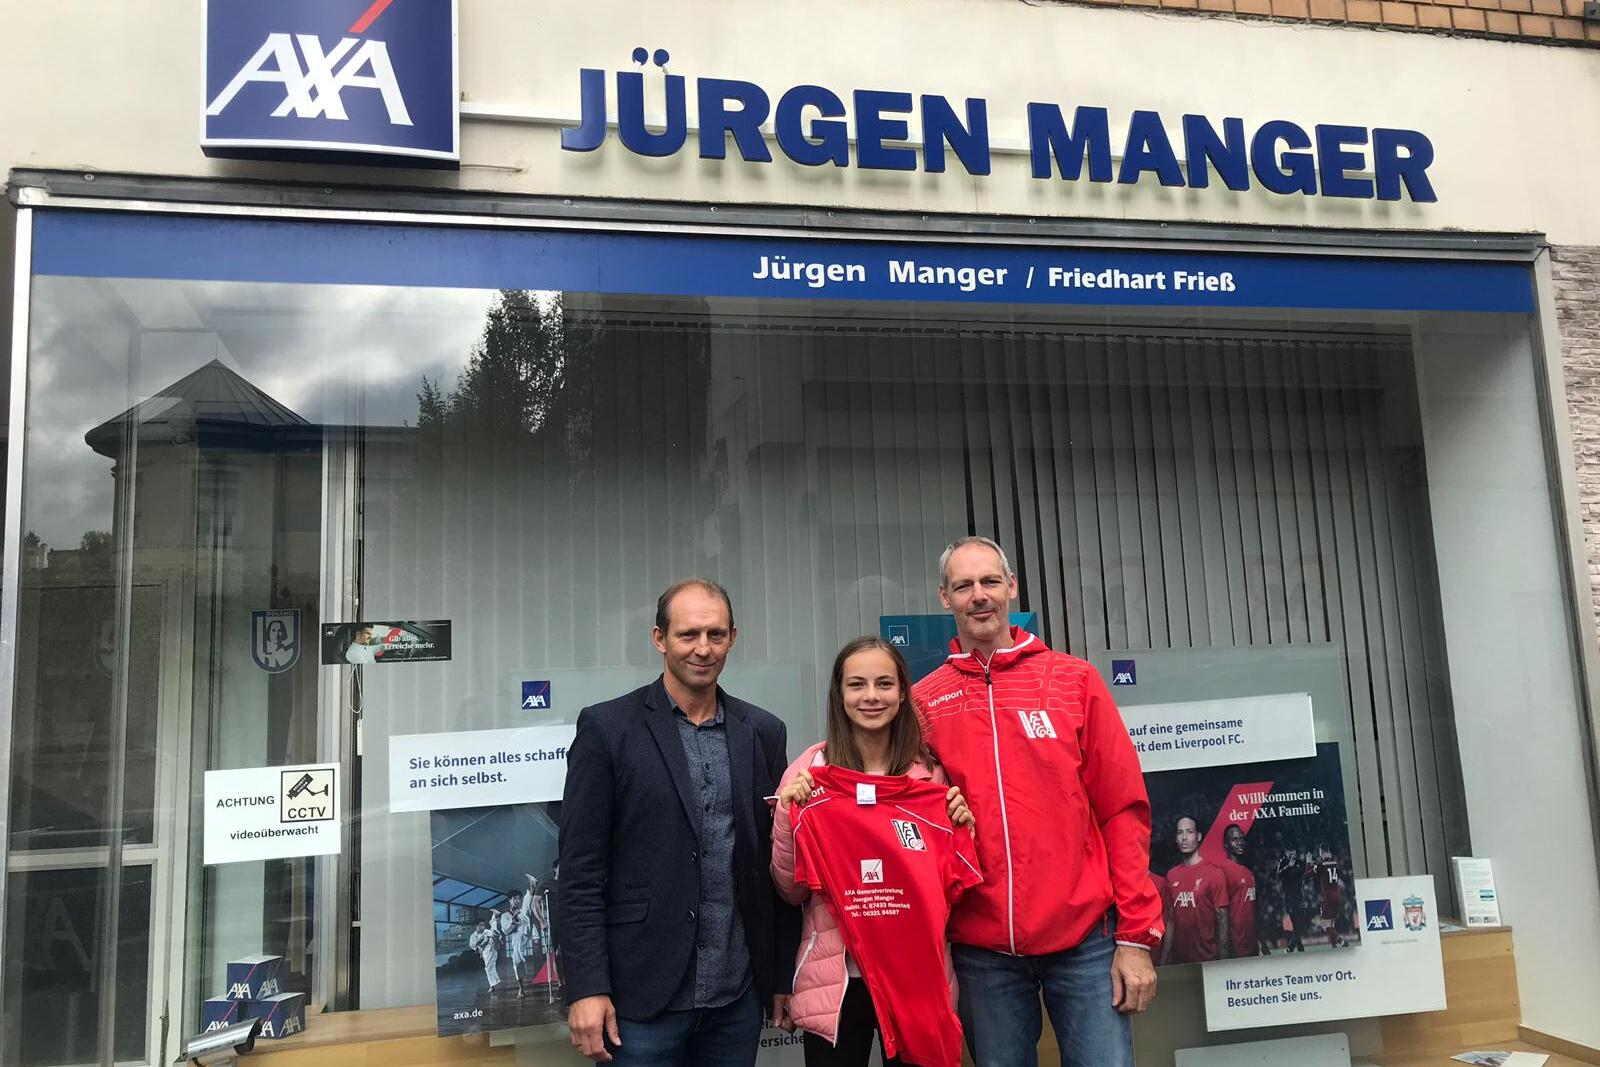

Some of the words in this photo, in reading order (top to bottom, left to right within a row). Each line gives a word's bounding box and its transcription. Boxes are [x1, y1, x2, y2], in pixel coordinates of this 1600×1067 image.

[206, 33, 414, 126] AXA
[561, 46, 992, 177] JÜRGEN
[1027, 102, 1438, 202] MANGER
[752, 255, 866, 288] Jürgen
[889, 260, 1008, 292] Manger
[1026, 266, 1034, 289] /
[1048, 266, 1166, 290] Friedhart
[1173, 270, 1236, 292] Frieß
[415, 641, 435, 649] mehr.
[890, 635, 906, 644] AXA
[1113, 672, 1133, 683] AXA
[522, 694, 546, 708] AXA
[1129, 724, 1147, 736] auf
[1149, 723, 1173, 735] eine
[1175, 719, 1243, 736] gemeinsame
[1148, 740, 1172, 752] dem
[1175, 734, 1226, 750] Liverpool
[1228, 733, 1245, 745] FC.
[409, 756, 431, 770] Sie
[434, 755, 486, 768] können
[489, 751, 522, 764] alles
[409, 778, 427, 789] an
[430, 774, 458, 787] sich
[462, 770, 507, 785] selbst.
[216, 795, 275, 808] ACHTUNG
[1238, 789, 1311, 805] Willkommen
[1313, 787, 1325, 799] in
[287, 806, 326, 819] CCTV
[1229, 809, 1249, 821] der
[1252, 806, 1277, 819] AXA
[1278, 803, 1321, 817] Familie
[230, 825, 320, 840] videoüberwacht
[862, 871, 880, 881] AXA
[1327, 867, 1338, 884] 14
[1173, 891, 1196, 908] AXA
[1367, 915, 1389, 929] AXA
[1226, 979, 1241, 991] Ihr
[1243, 976, 1283, 989] starkes
[1285, 974, 1313, 985] Team
[1315, 972, 1333, 983] vor
[1335, 969, 1356, 981] Ort.
[226, 982, 252, 1000] AXA
[256, 978, 280, 1000] AXA
[1227, 994, 1279, 1008] Besuchen
[1281, 991, 1297, 1003] Sie
[1299, 991, 1322, 1002] uns.
[453, 1008, 483, 1020] axa.de
[279, 1015, 301, 1037] AXA
